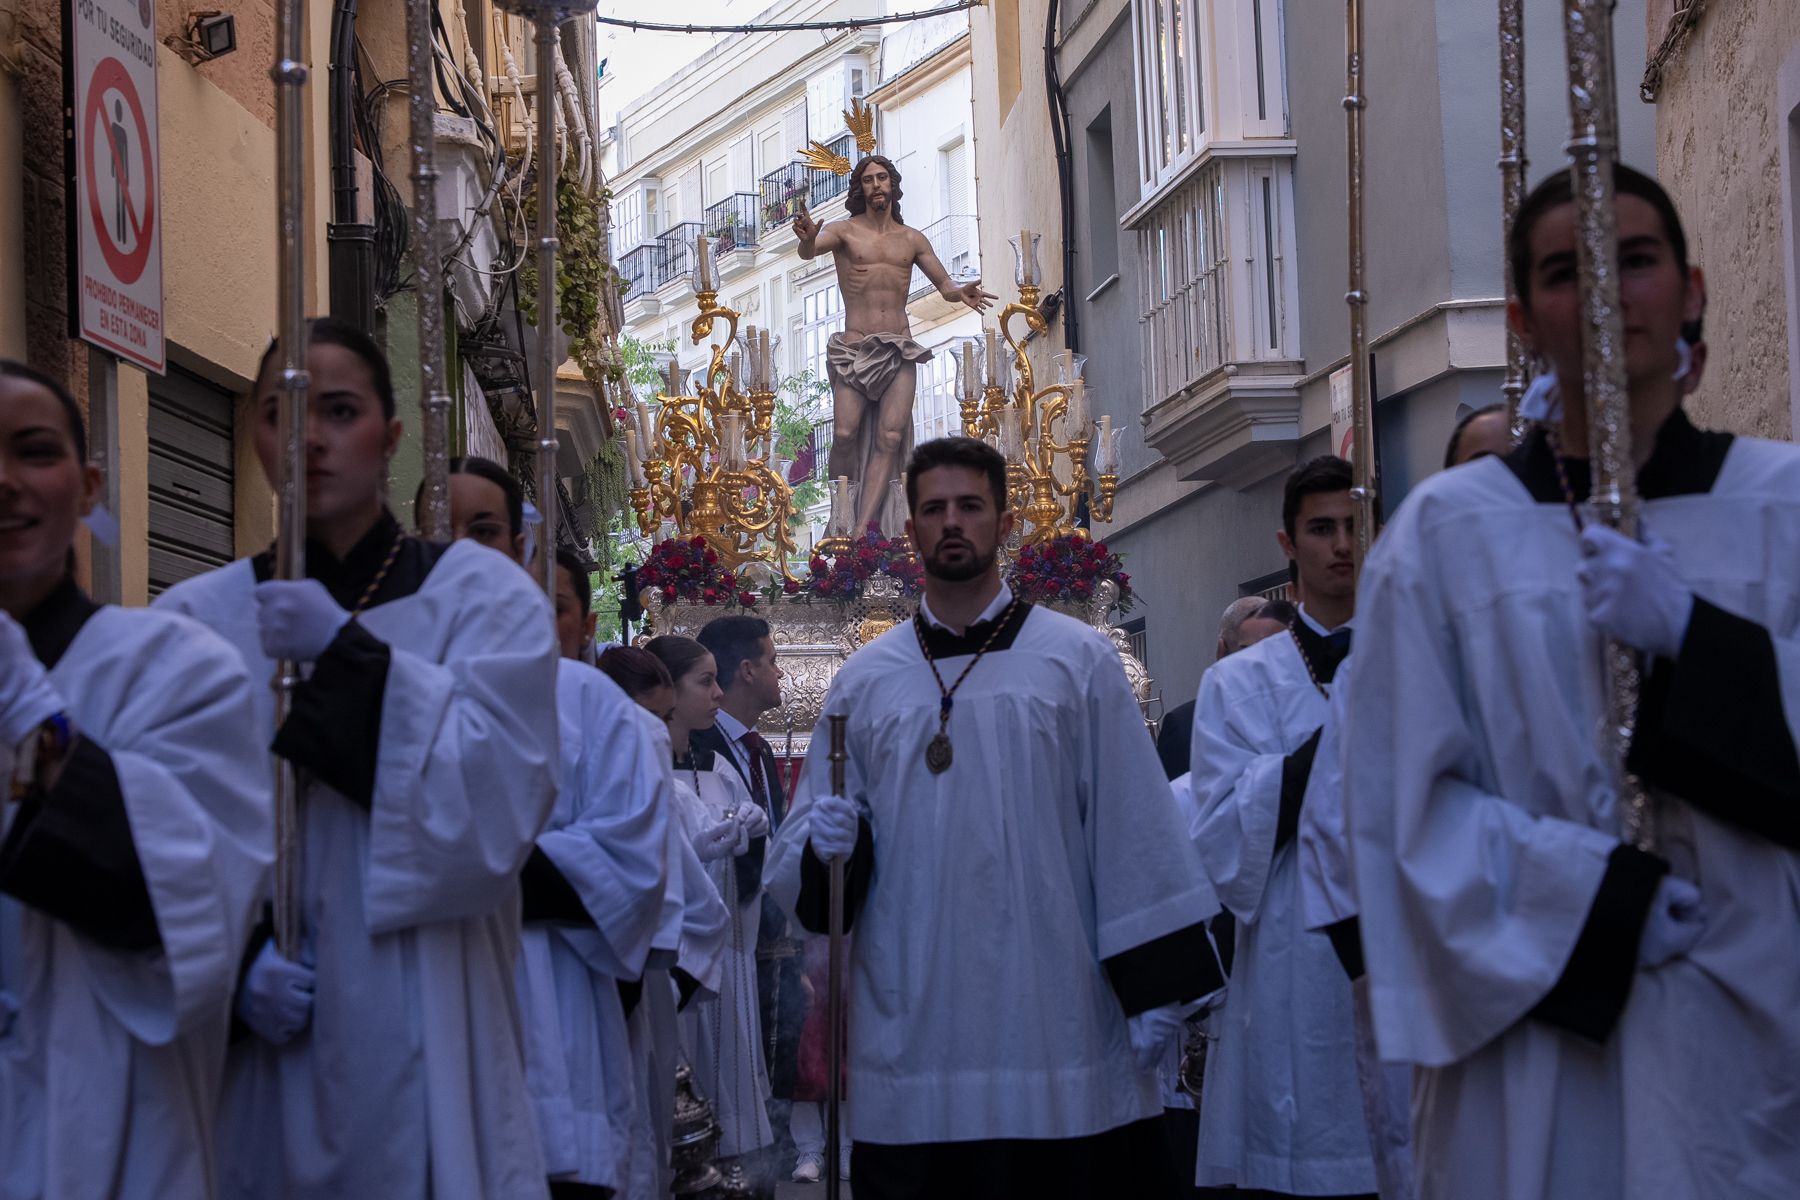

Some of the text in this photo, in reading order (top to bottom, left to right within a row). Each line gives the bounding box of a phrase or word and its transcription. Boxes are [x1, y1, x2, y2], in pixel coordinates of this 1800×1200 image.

[78, 0, 153, 68] POR TU SEGURIDAD
[100, 308, 147, 348] EN ESTA ZONA
[118, 293, 160, 331] PERMANECER
